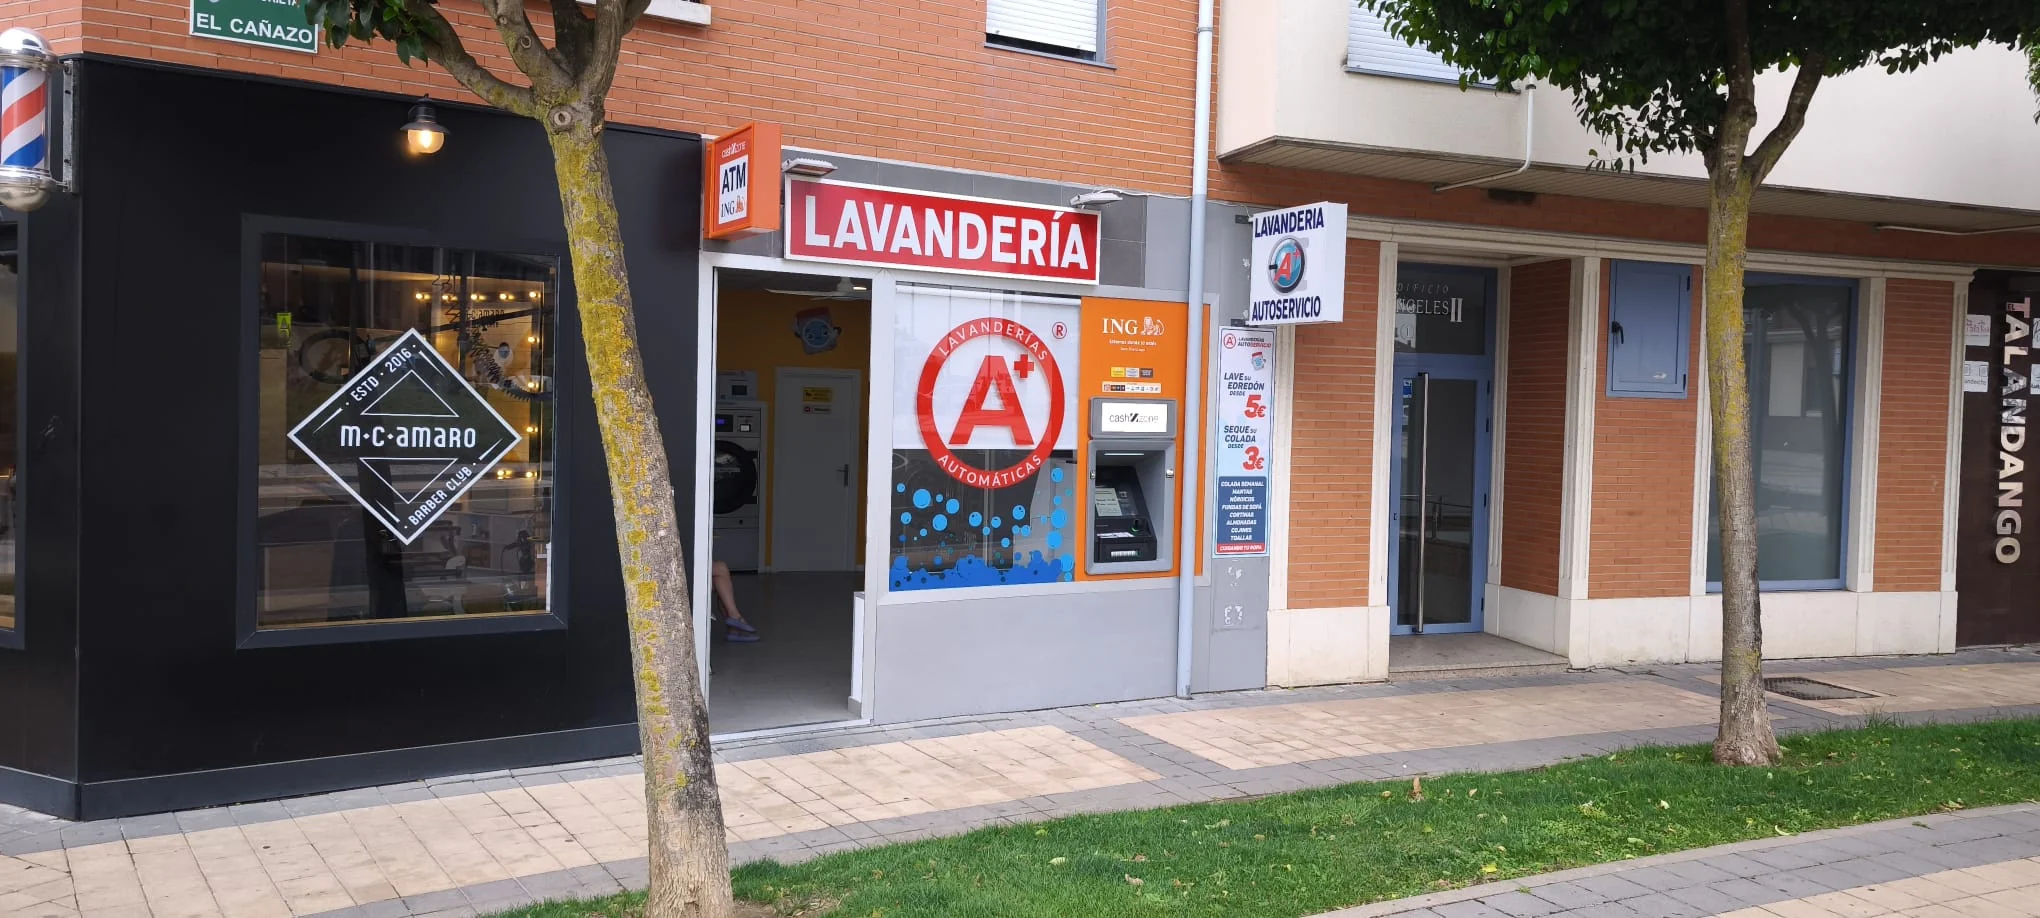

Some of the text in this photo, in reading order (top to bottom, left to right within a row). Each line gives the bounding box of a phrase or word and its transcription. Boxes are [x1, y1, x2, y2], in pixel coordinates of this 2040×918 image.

[196, 12, 313, 44] EL CAÑAZO
[721, 162, 747, 194] ATM
[720, 200, 735, 217] ING
[804, 194, 1089, 270] LAVANDERÍA
[1254, 206, 1325, 238] LAVANDERIA
[1396, 281, 1449, 295] DIFICIO
[1251, 295, 1321, 322] AUTOSERVICIO
[1395, 298, 1449, 315] NGELES
[1102, 317, 1139, 335] ING
[938, 320, 1048, 361] LAVANDERÍAS
[350, 347, 413, 402] ESTD 2016
[1223, 372, 1245, 381] LAVE
[1227, 381, 1265, 391] EDREDÓN
[1243, 394, 1267, 419] 5€
[1223, 425, 1250, 434] SEQUE
[1224, 434, 1257, 443] COLADA
[1996, 296, 2032, 564] TALANDANGO
[938, 454, 1042, 487] AUTOMÁTICAS
[1242, 445, 1265, 471] 3€
[408, 465, 474, 526] BARBER CLUB
